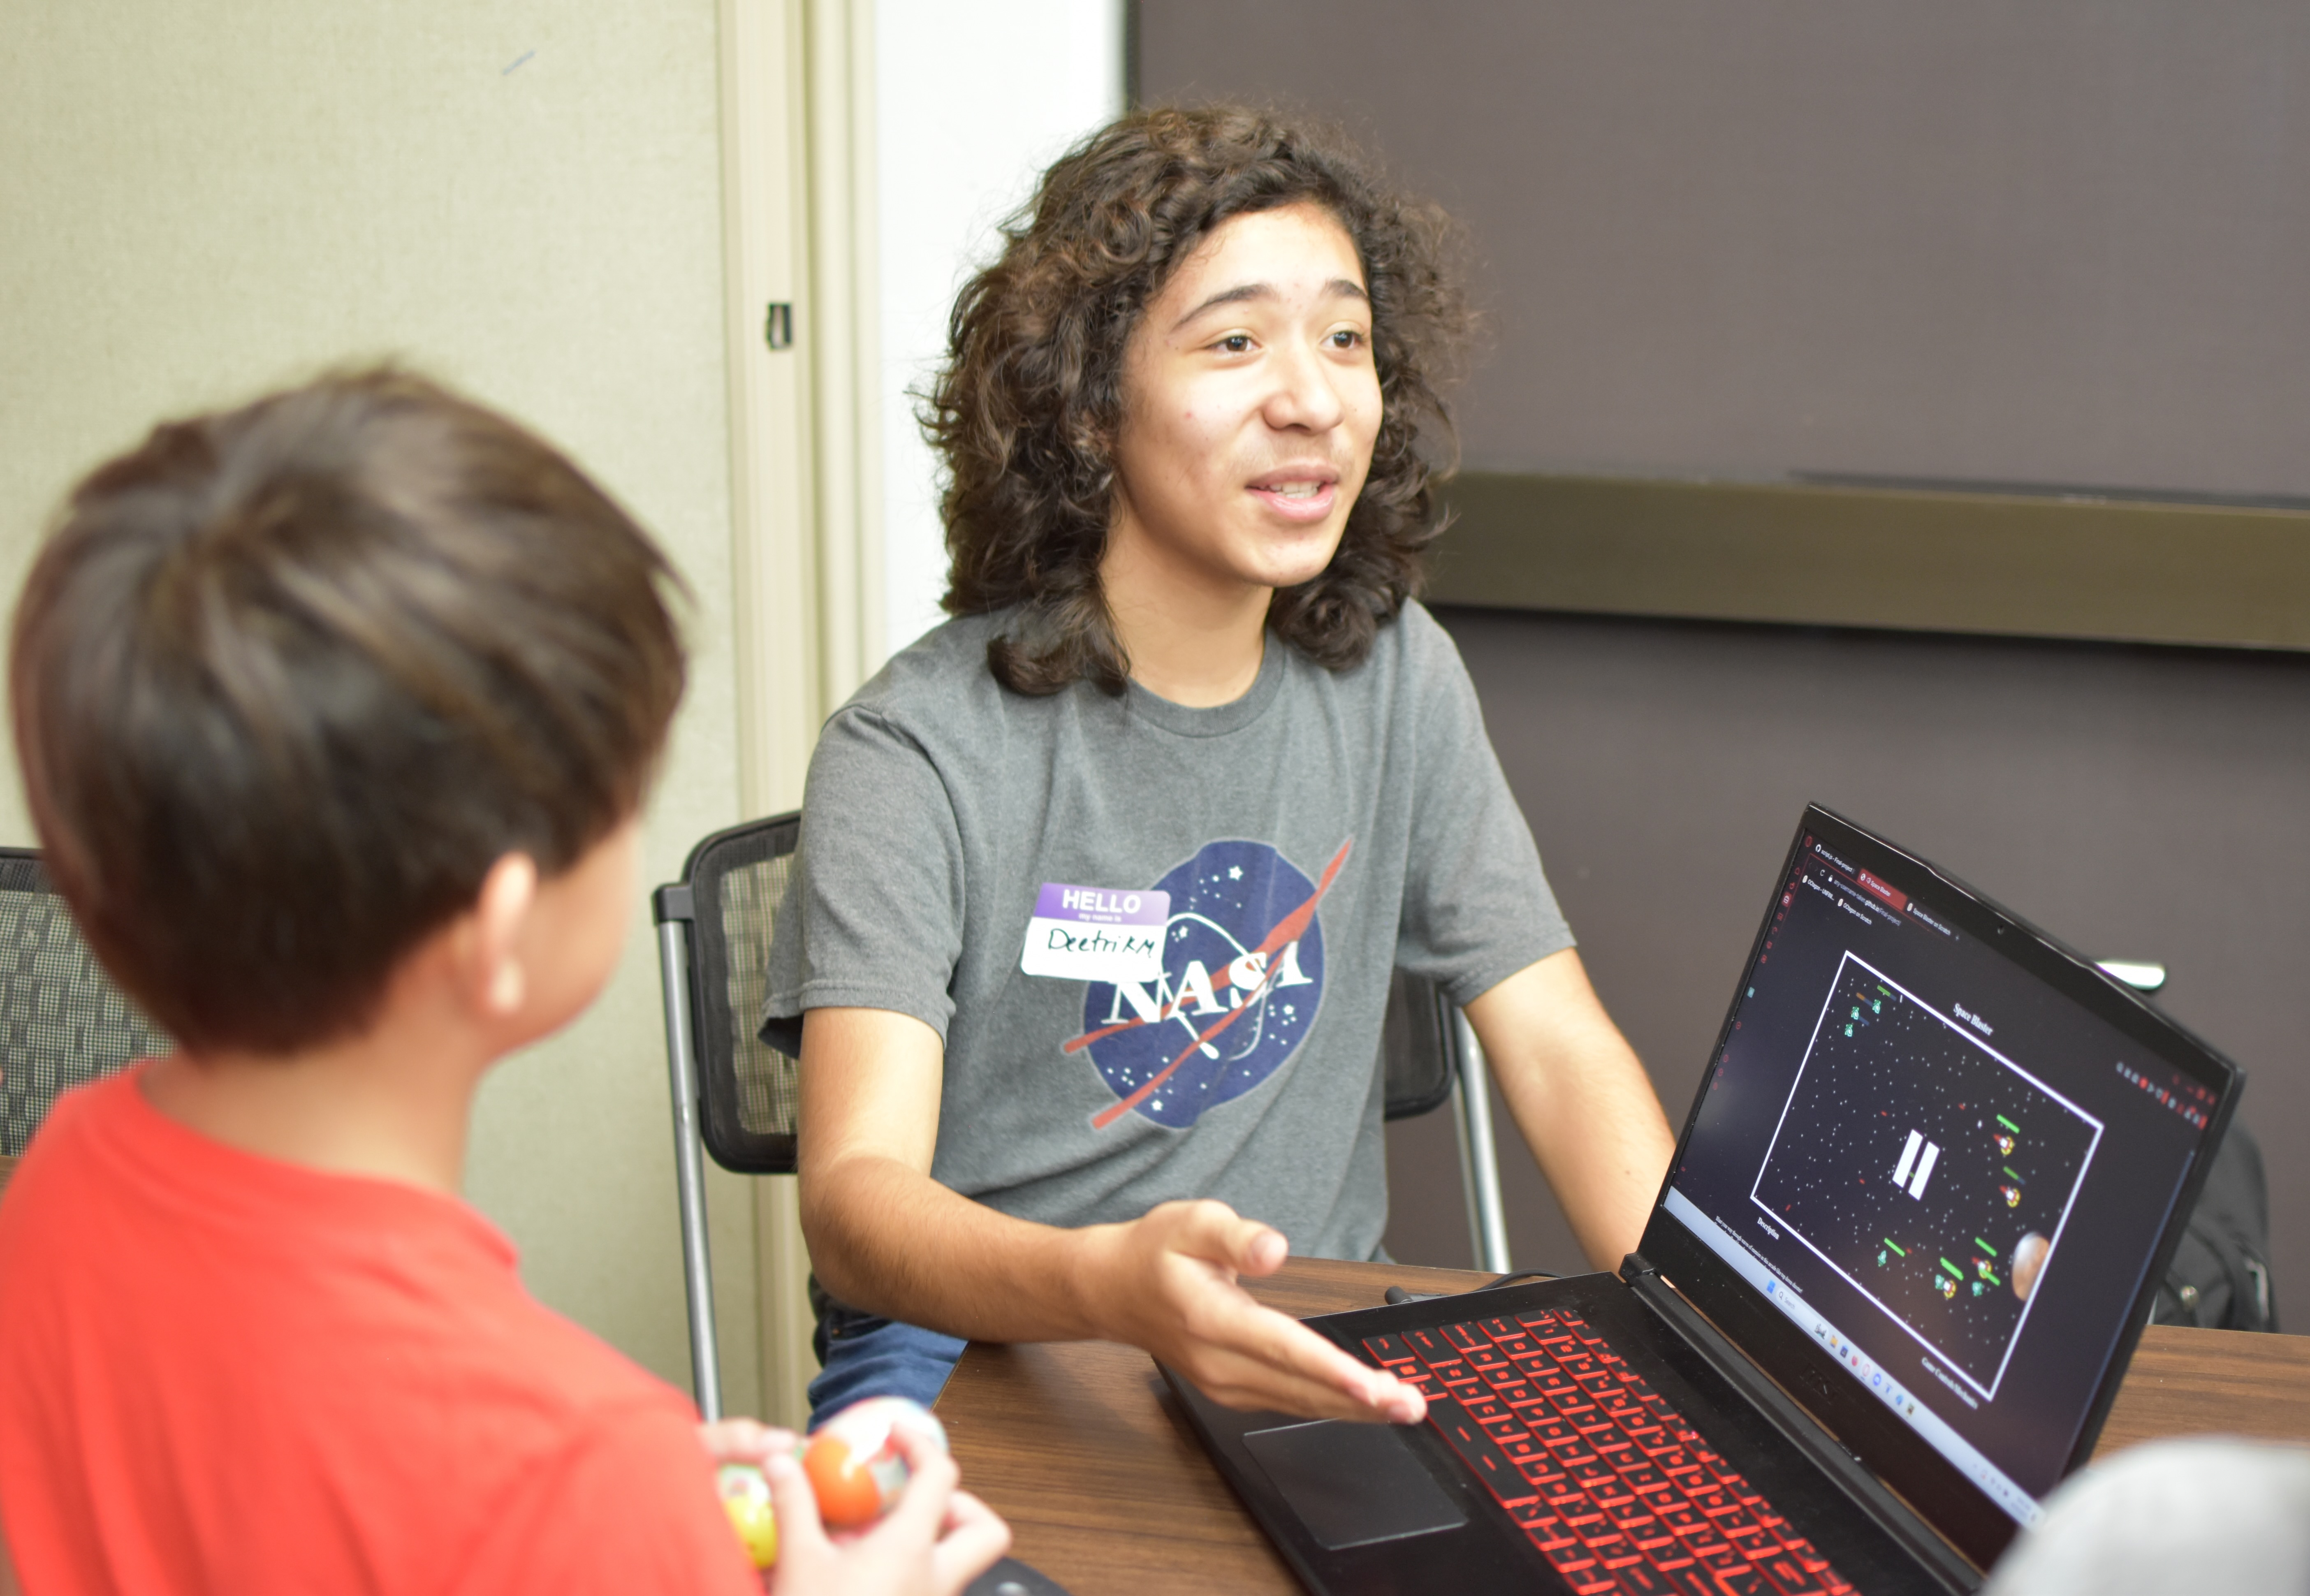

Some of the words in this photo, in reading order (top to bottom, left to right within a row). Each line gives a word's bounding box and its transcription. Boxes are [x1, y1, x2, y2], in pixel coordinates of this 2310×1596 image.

[1870, 880, 1881, 890] Space
[1880, 886, 1891, 896] Blaster
[1062, 889, 1141, 914] HELLO
[1078, 913, 1090, 922] my
[1092, 914, 1113, 922] name
[1114, 914, 1122, 922] is
[1860, 914, 1872, 925] Scratch
[1913, 908, 1923, 918] Space
[1923, 914, 1934, 925] Blaster
[1938, 924, 1951, 936] Scratch
[1101, 940, 1313, 1024] NASA
[1953, 1003, 1972, 1022] Space
[1970, 1014, 1993, 1036] Blaster
[1756, 1216, 1780, 1240] Description
